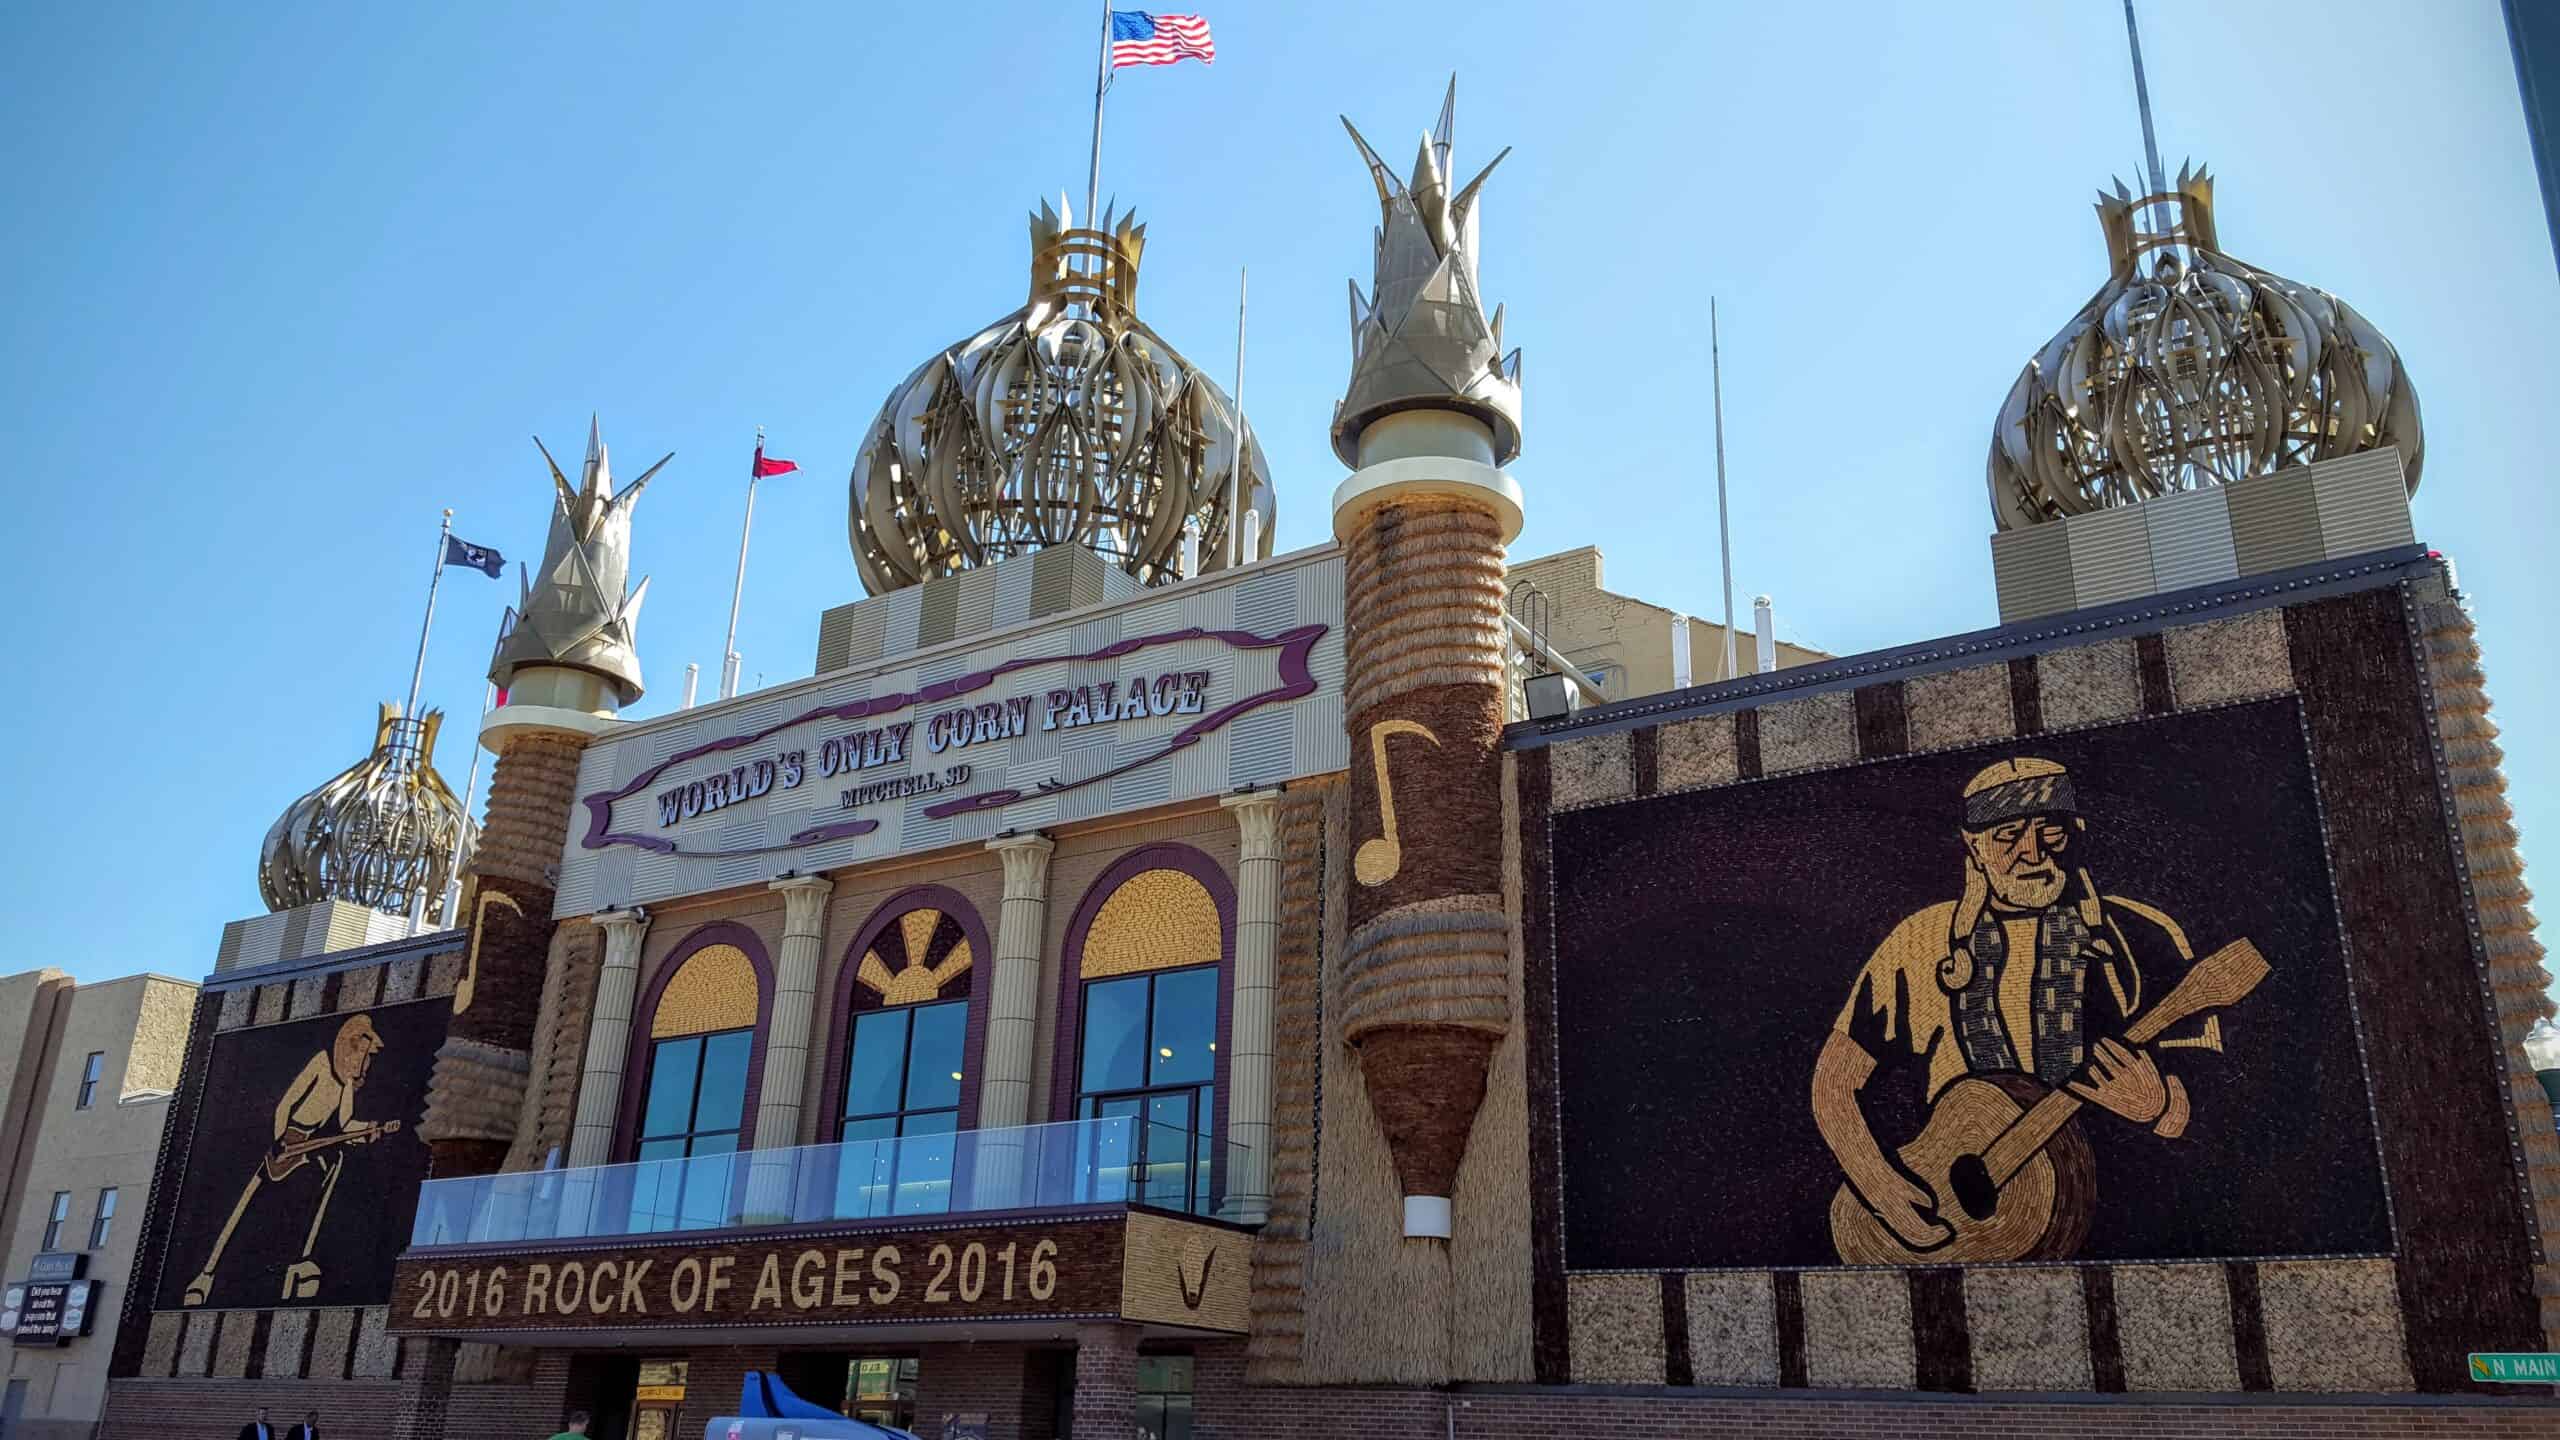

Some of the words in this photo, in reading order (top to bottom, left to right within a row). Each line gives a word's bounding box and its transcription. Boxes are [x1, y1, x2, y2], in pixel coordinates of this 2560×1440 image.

[656, 750, 805, 828] WORLD'S
[817, 721, 912, 778] ONLY
[927, 695, 1032, 754] CORN
[1042, 670, 1209, 732] PALACE
[840, 771, 942, 810] MITCHELL,
[945, 764, 971, 787] SD
[413, 1266, 508, 1319] 2016
[522, 1259, 654, 1316] ROCK
[669, 1256, 736, 1314] OF
[750, 1245, 901, 1311] AGES
[923, 1239, 1058, 1303] 2016
[2492, 1359, 2506, 1377] N
[2513, 1359, 2558, 1377] MAIN
